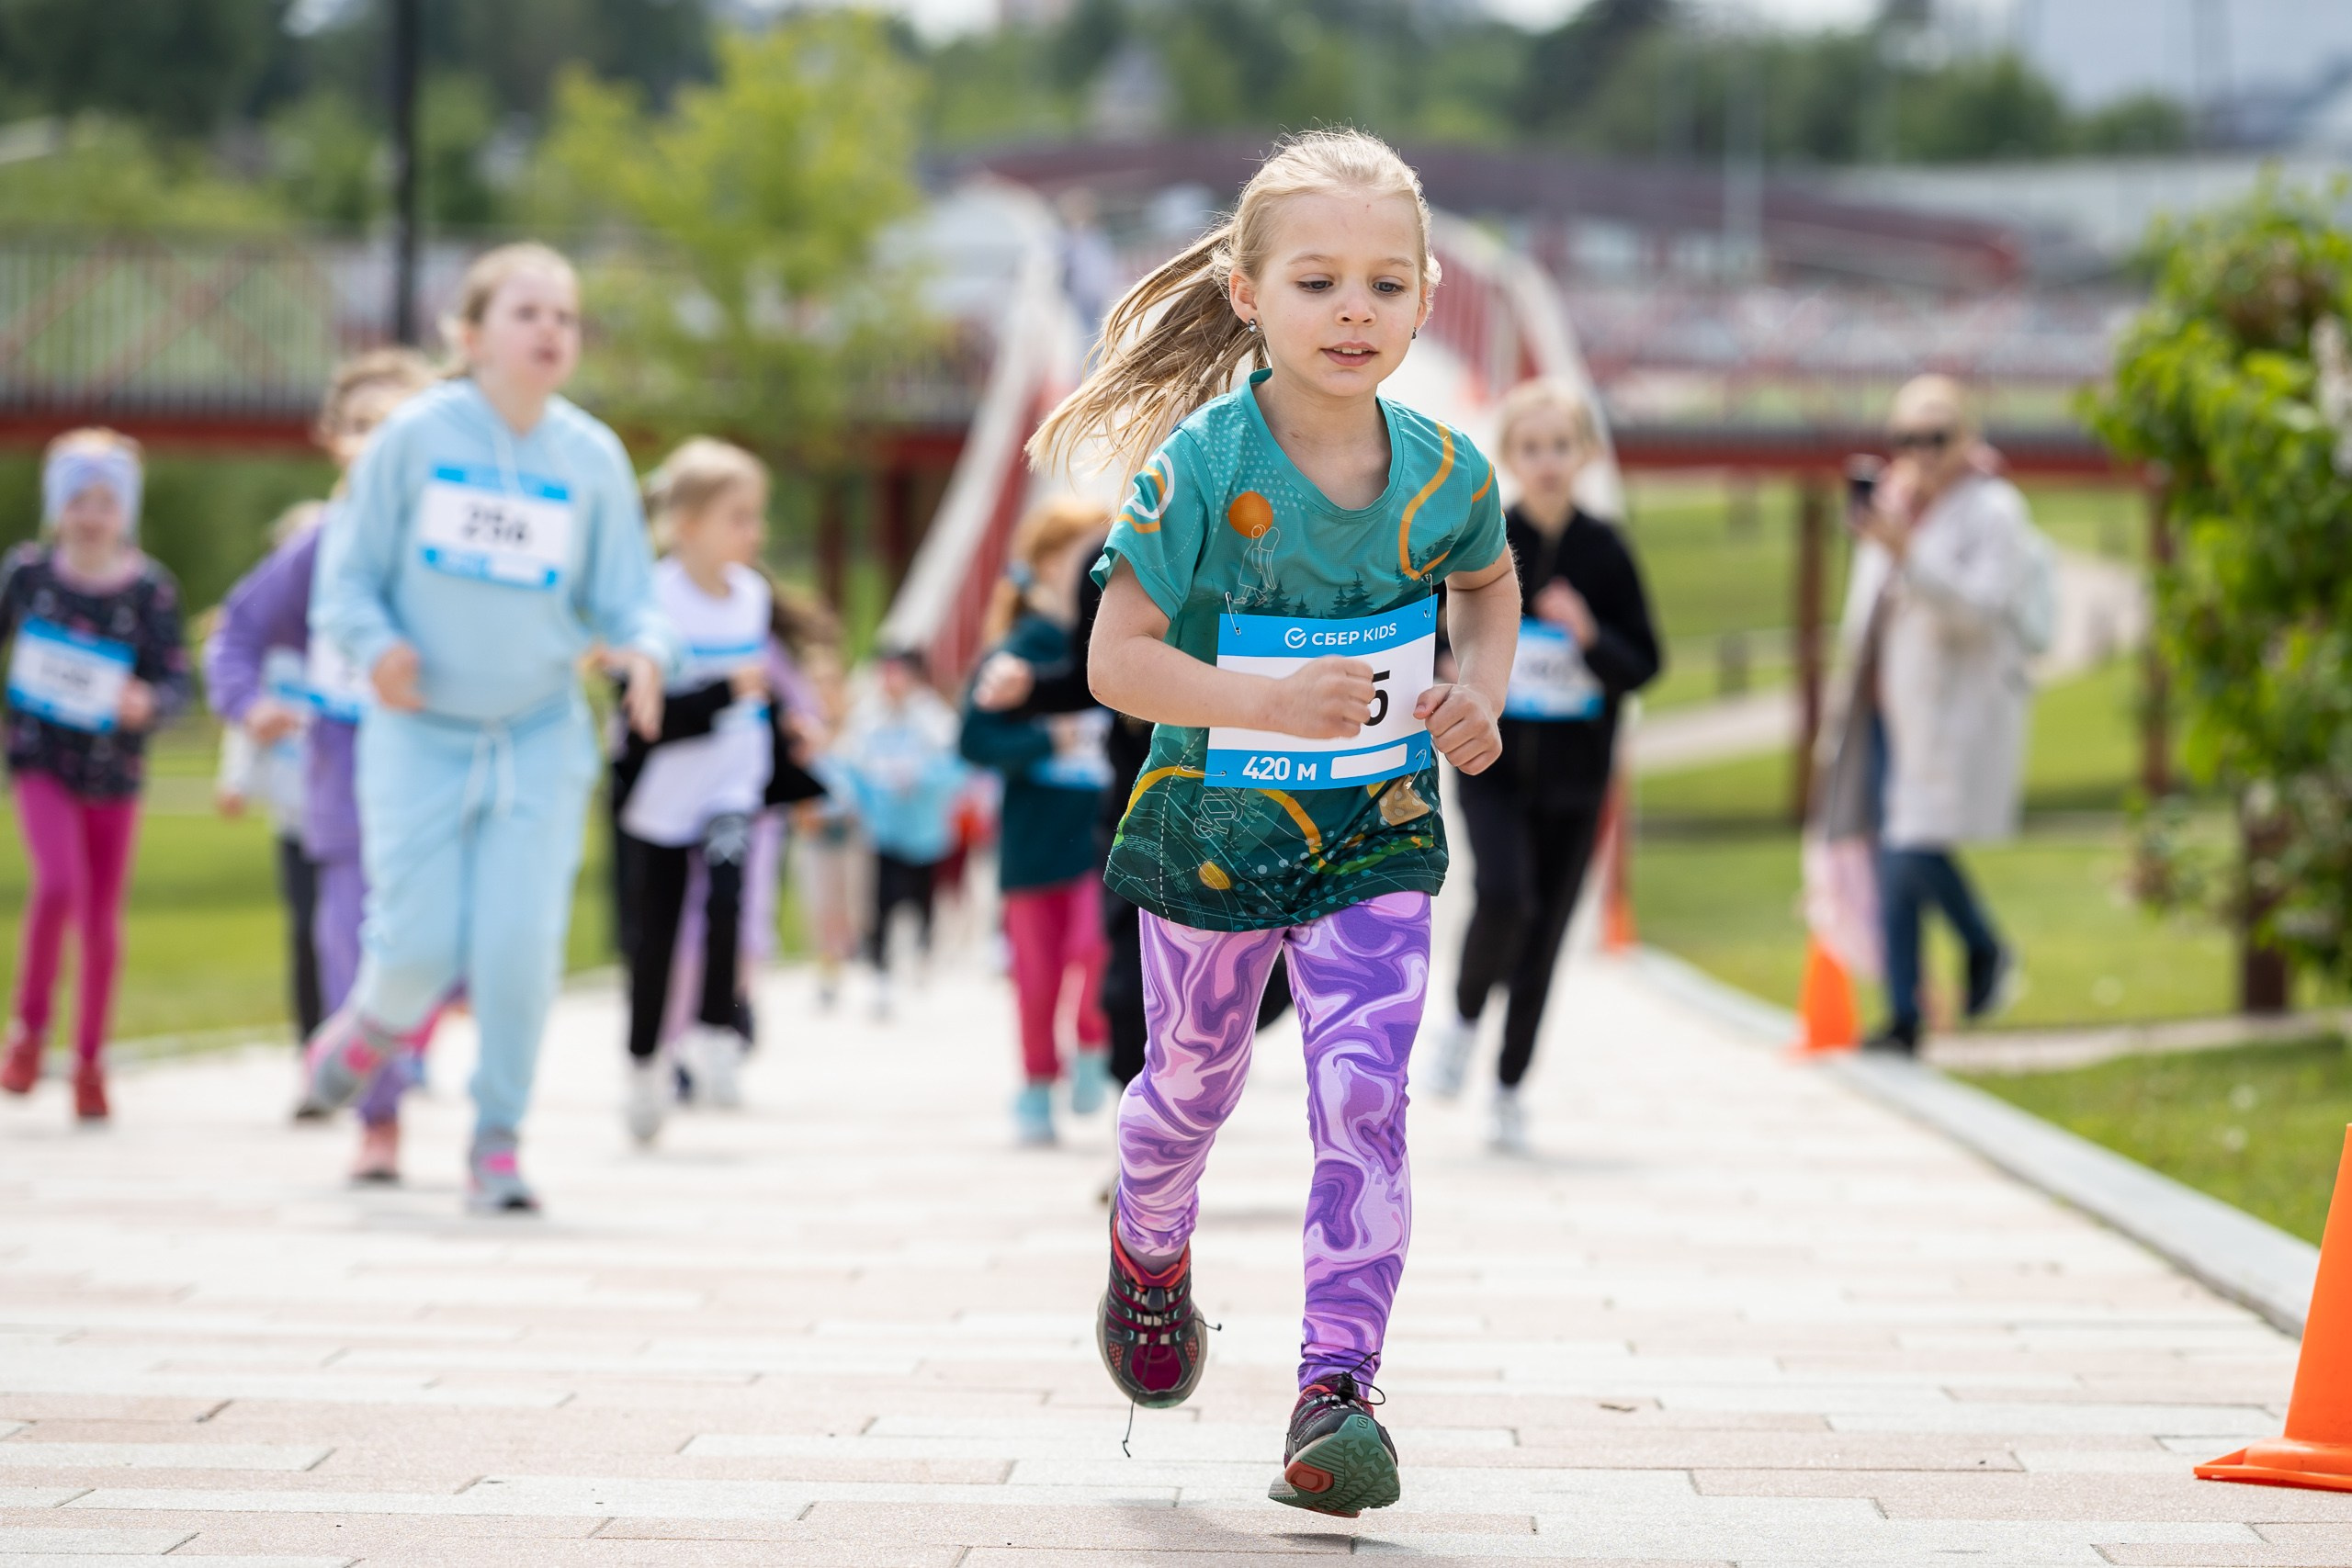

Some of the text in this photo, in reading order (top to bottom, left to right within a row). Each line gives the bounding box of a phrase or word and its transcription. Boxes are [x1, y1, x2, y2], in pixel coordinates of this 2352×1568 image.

[1311, 622, 1397, 646] СБЕР KIDS
[1242, 756, 1291, 781] 420
